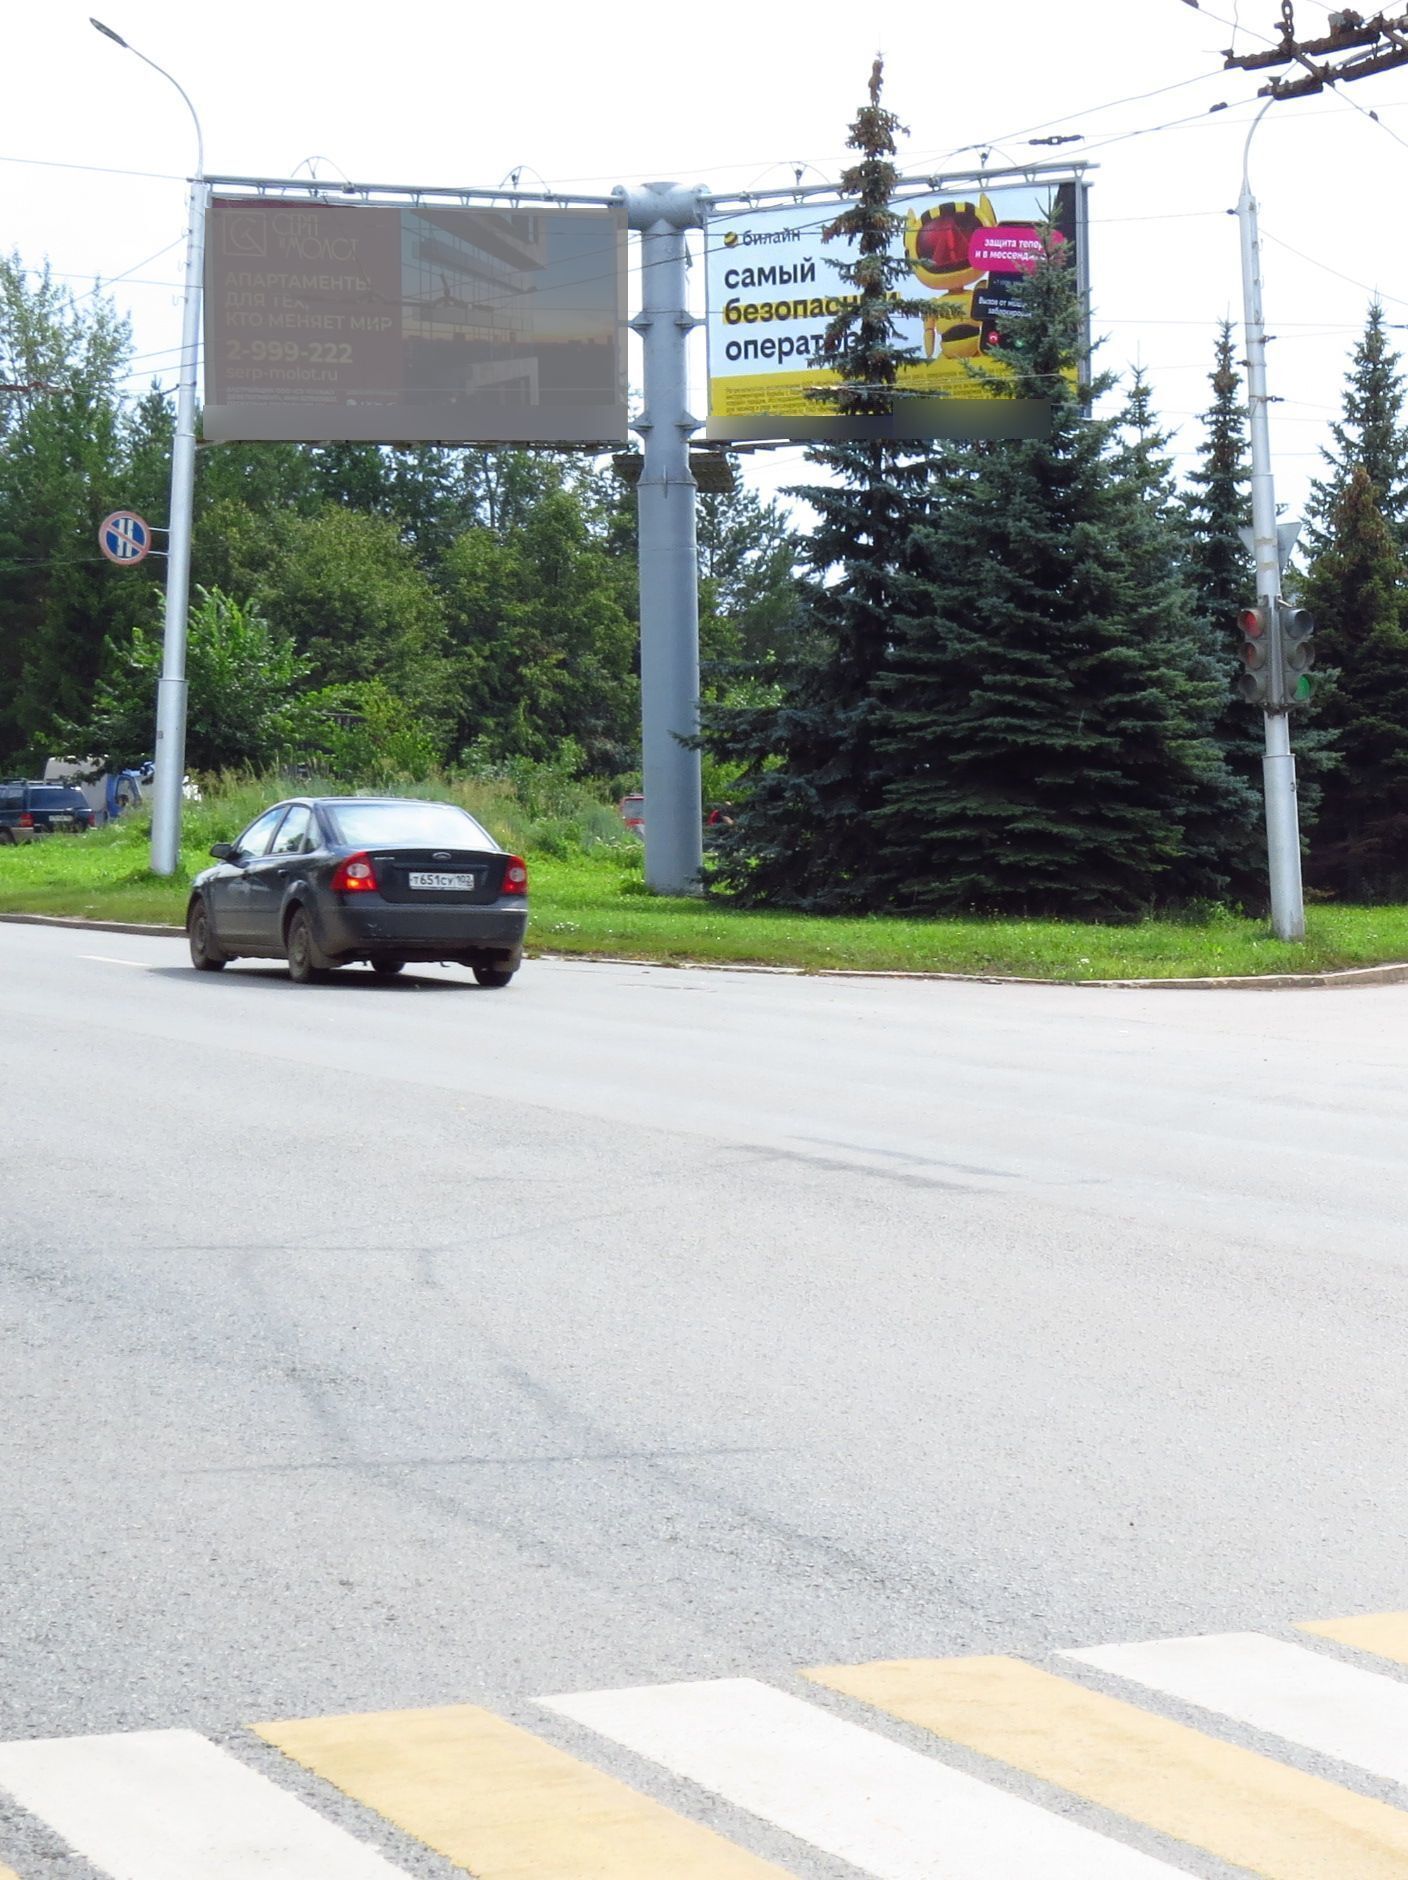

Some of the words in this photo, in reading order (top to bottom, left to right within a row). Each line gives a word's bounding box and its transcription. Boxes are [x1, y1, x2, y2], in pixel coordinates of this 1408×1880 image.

[743, 228, 801, 246] билайн
[225, 271, 371, 290] АПАРТАМЕНТЫ
[724, 256, 816, 289] самый
[224, 291, 266, 309] ДЛЯ
[226, 311, 263, 328] КТО
[268, 313, 345, 330] МЕНЯЕТ
[350, 316, 393, 332] МИР
[225, 339, 353, 365] 2-999-222
[224, 366, 338, 383] serp-molot.ru
